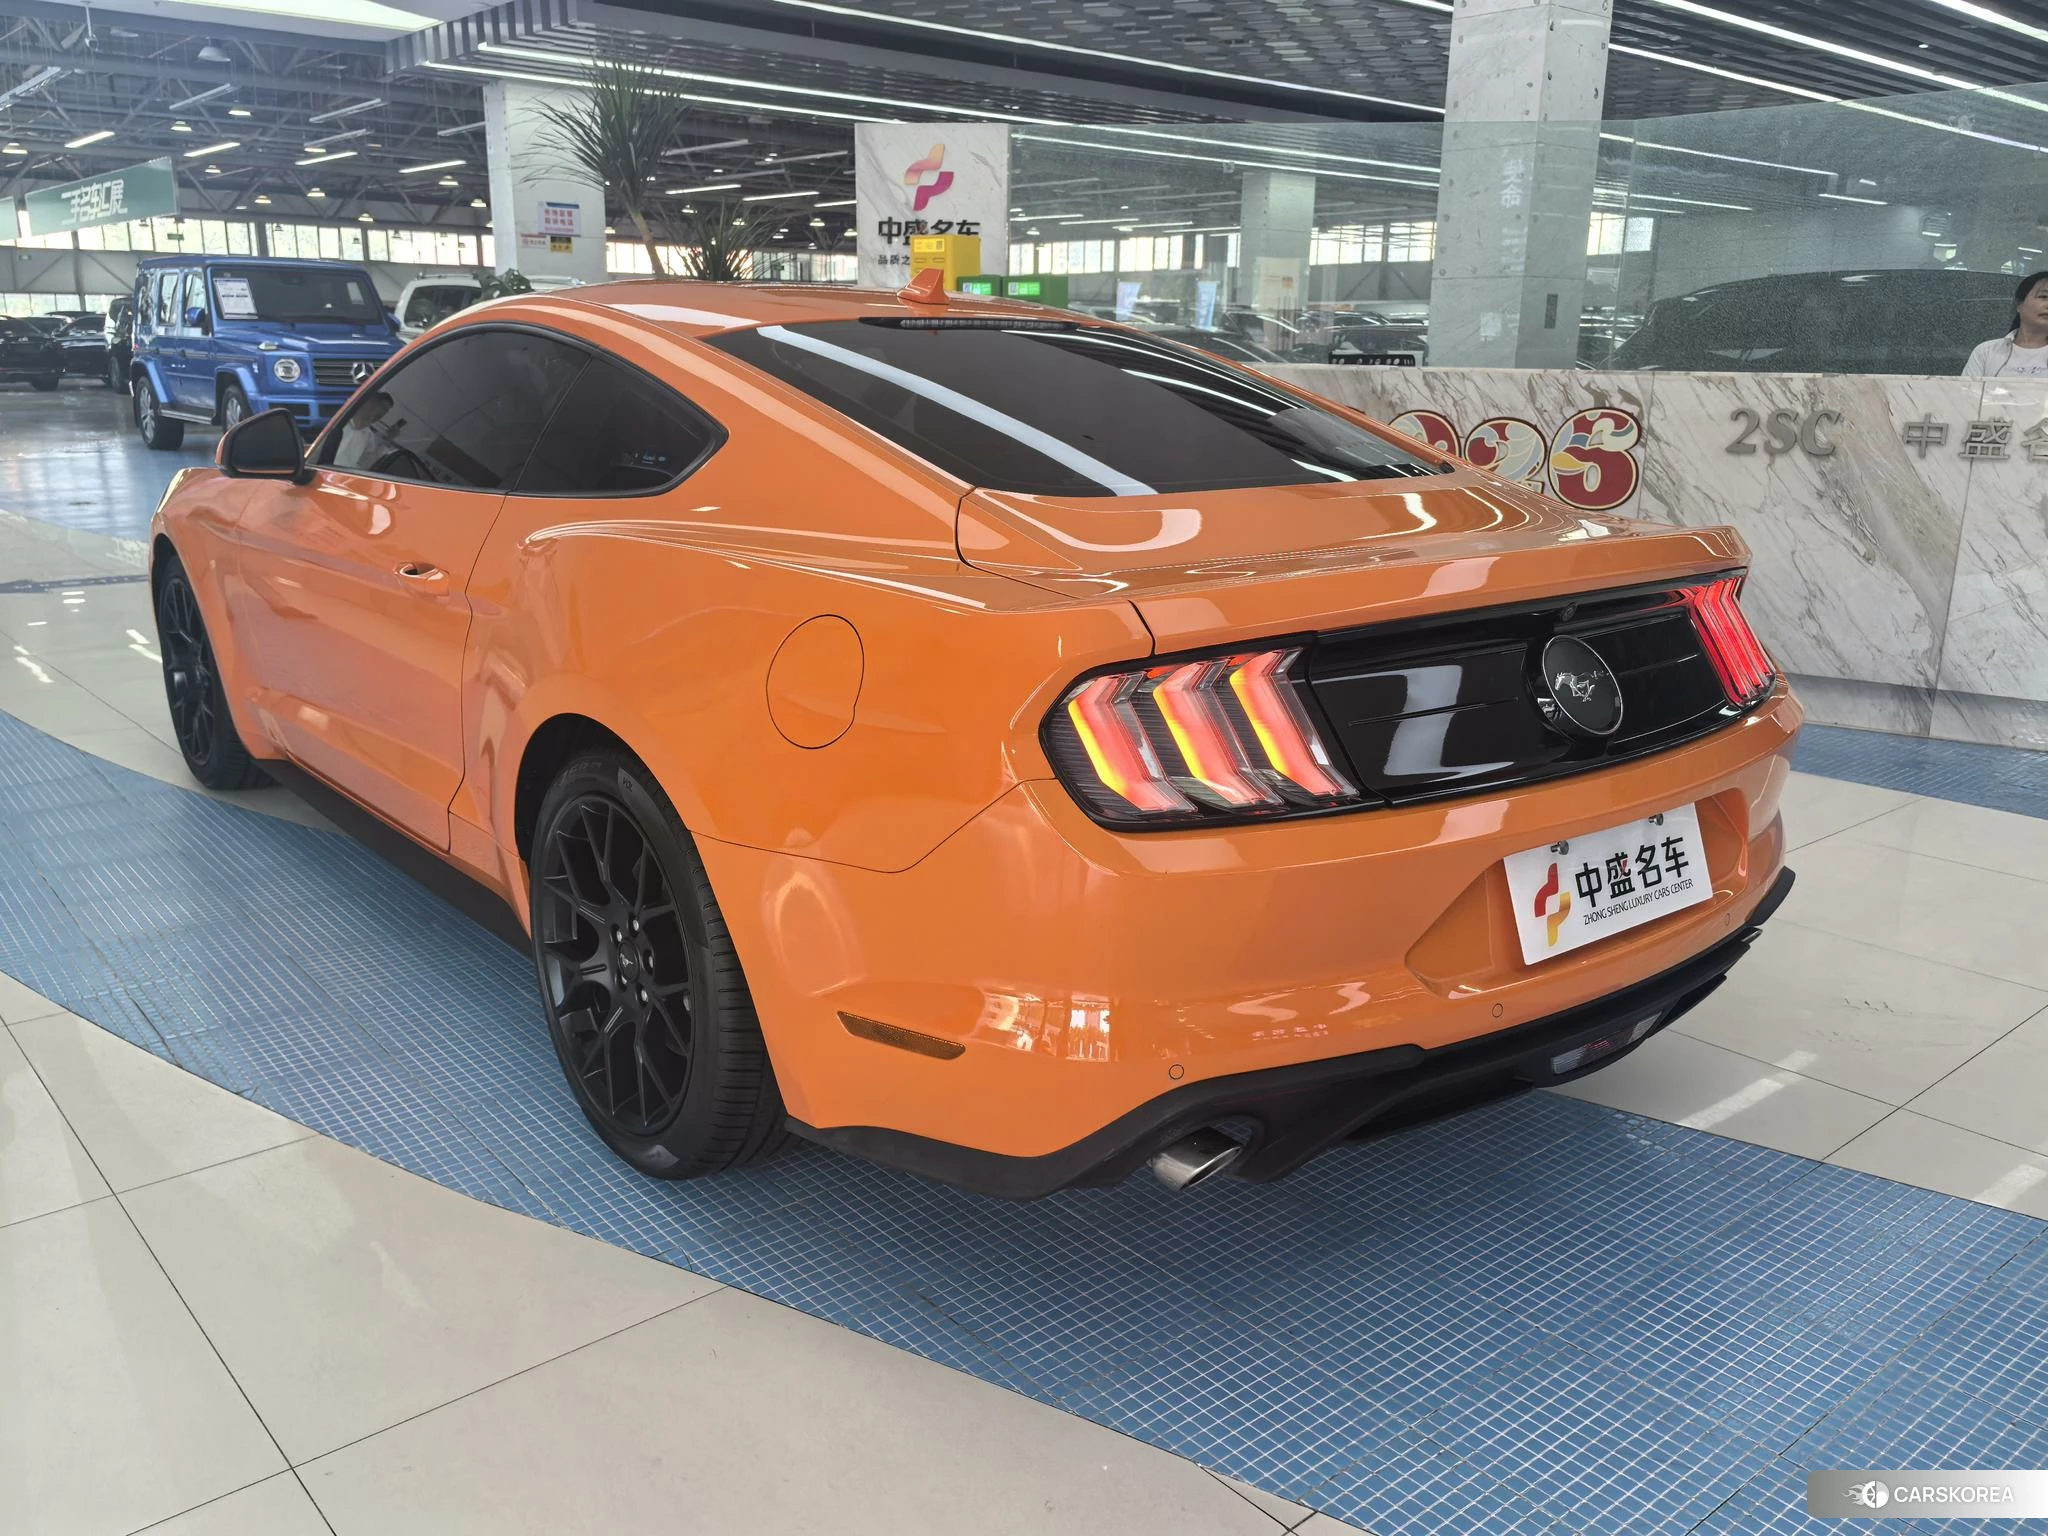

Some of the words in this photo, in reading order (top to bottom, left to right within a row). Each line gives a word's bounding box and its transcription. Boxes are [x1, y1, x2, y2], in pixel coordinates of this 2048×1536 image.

[1725, 408, 1841, 457] 2SC
[1575, 836, 1689, 908] 中盛名车
[1583, 908, 1608, 925] ZHONG
[1607, 899, 1629, 917] SHENG
[1629, 891, 1653, 910] LUXURY
[1654, 886, 1671, 900] CARS
[1671, 878, 1694, 894] CENTER
